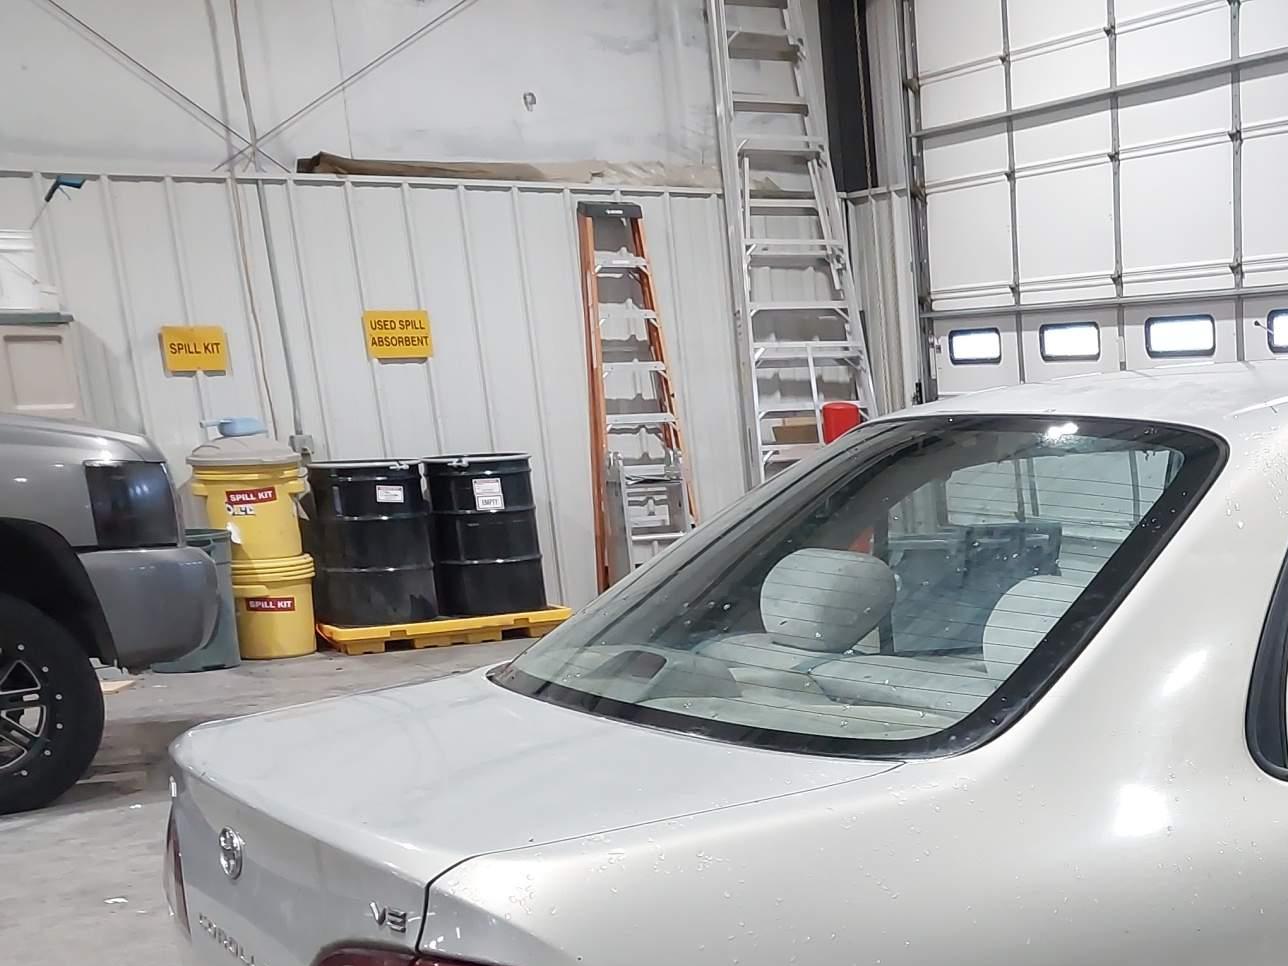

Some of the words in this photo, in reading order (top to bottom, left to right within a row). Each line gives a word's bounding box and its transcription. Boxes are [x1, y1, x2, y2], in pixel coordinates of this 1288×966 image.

[370, 319, 397, 330] USED
[399, 319, 426, 330] SPILL
[371, 335, 429, 347] ABSORBENT
[169, 342, 202, 354] SPILL
[203, 342, 221, 354] KIT
[229, 493, 257, 502] SPILL
[257, 490, 273, 499] KIT
[249, 600, 276, 609] SPILL
[277, 600, 293, 609] KIT
